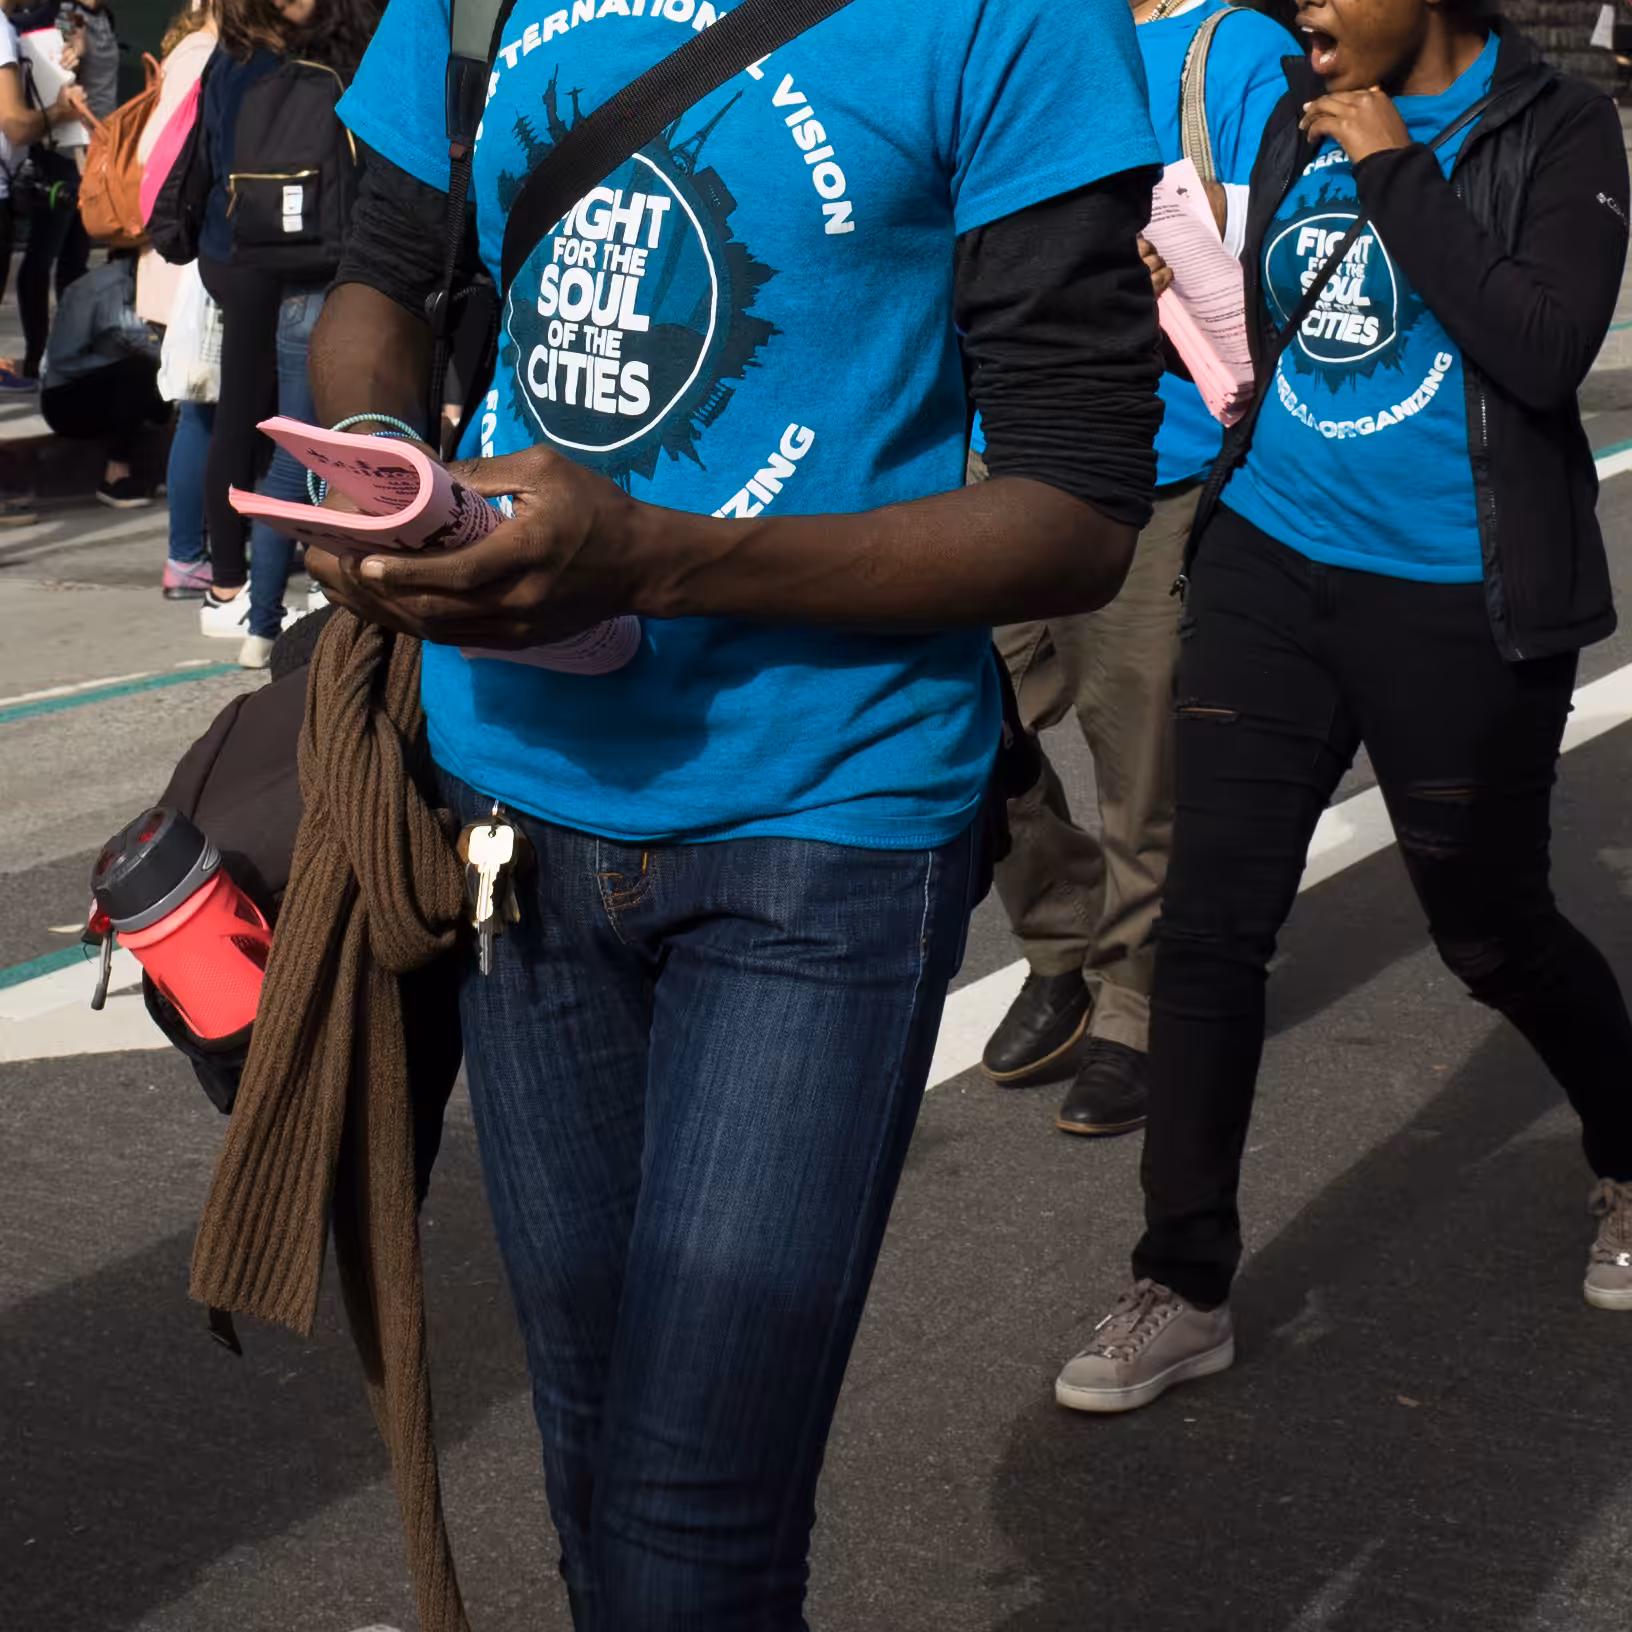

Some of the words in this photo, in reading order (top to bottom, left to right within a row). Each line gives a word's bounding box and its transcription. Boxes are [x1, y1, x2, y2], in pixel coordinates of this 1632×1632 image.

[772, 73, 855, 234] VISION
[548, 186, 671, 249] IGHT
[553, 236, 598, 268] FOR
[602, 243, 649, 276] THE
[537, 264, 650, 332] SOUL
[1301, 309, 1379, 346] CITIES
[548, 319, 579, 349] OF
[583, 324, 623, 358] THE
[527, 344, 651, 416] CITIES
[1319, 352, 1453, 439] ORGANIZING
